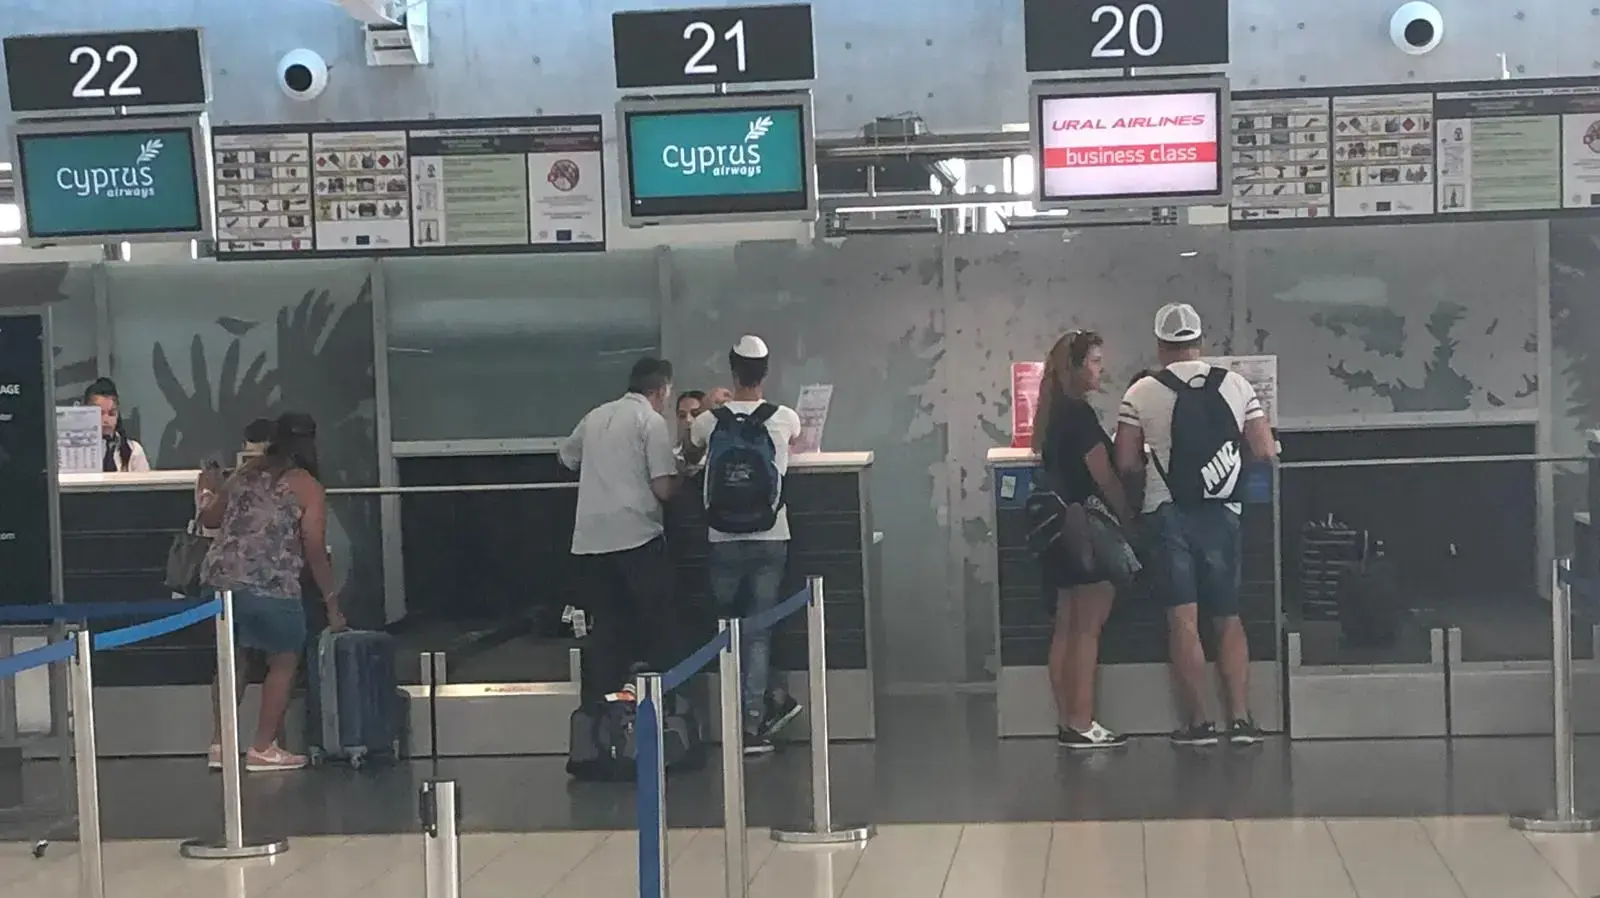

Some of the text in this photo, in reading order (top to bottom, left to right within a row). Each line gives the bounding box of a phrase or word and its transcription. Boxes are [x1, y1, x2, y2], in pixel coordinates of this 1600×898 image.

[1091, 4, 1163, 58] 20
[683, 20, 746, 74] 21
[69, 45, 142, 97] 22
[1052, 114, 1205, 132] URAL AIRLINES
[1066, 144, 1197, 165] business class
[712, 165, 762, 177] airways
[106, 186, 155, 198] airways
